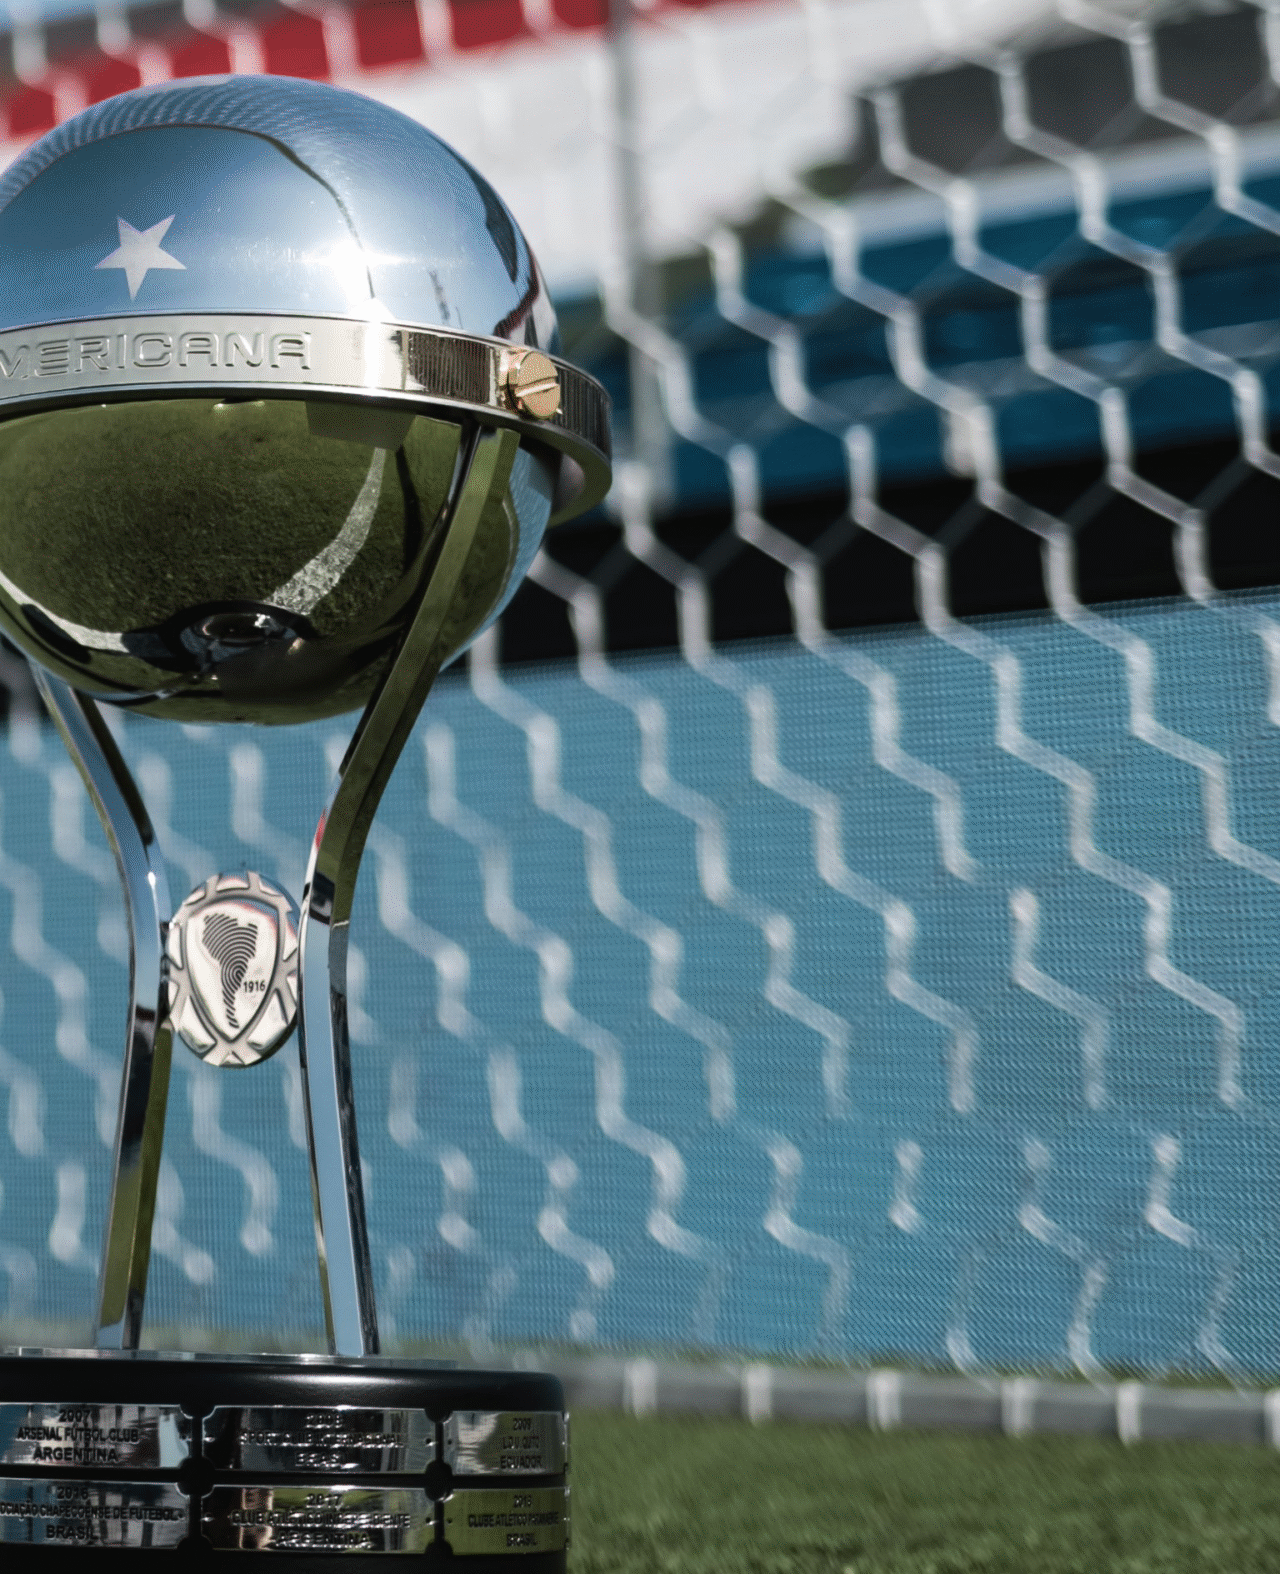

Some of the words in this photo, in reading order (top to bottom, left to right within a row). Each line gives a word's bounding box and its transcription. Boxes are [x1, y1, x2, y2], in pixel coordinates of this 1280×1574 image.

[242, 979, 266, 993] 1916
[58, 1409, 92, 1423] 2007
[17, 1427, 62, 1441] ARSENAL
[108, 1428, 140, 1443] CLUB
[33, 1447, 119, 1462] ARGENTINA
[500, 1455, 542, 1469] ECUADOR
[57, 1487, 89, 1499] 2016
[40, 1504, 110, 1519] CHAPECOENSE
[112, 1506, 128, 1519] DE
[129, 1506, 179, 1521] FUTEBOL
[230, 1512, 265, 1526] CLUB
[468, 1513, 495, 1527] CLUBE
[46, 1525, 99, 1540] BRASIL
